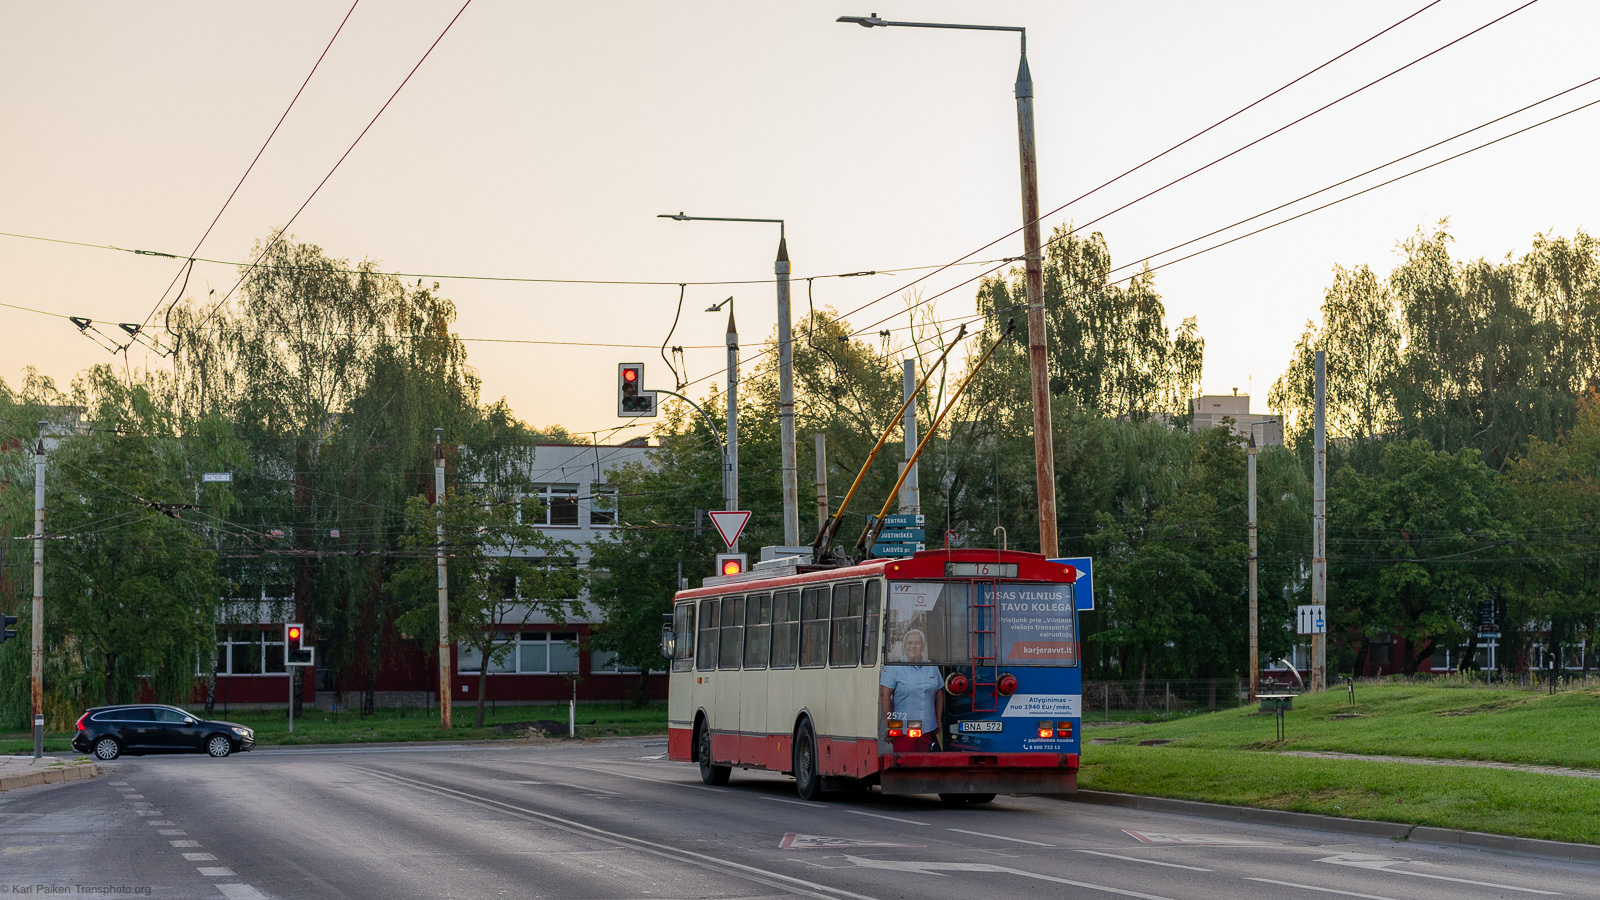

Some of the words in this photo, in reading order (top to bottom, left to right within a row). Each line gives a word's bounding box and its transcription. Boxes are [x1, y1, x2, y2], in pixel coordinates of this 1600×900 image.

[974, 563, 989, 575] 16
[984, 591, 1016, 600] VISAS
[1018, 591, 1062, 600] VILNIUS
[1001, 603, 1028, 612] TAVO
[1032, 603, 1072, 612] KOLEGA
[1024, 646, 1072, 654] karjeravvt.lt
[964, 722, 981, 730] BNA
[986, 722, 1001, 730] 572
